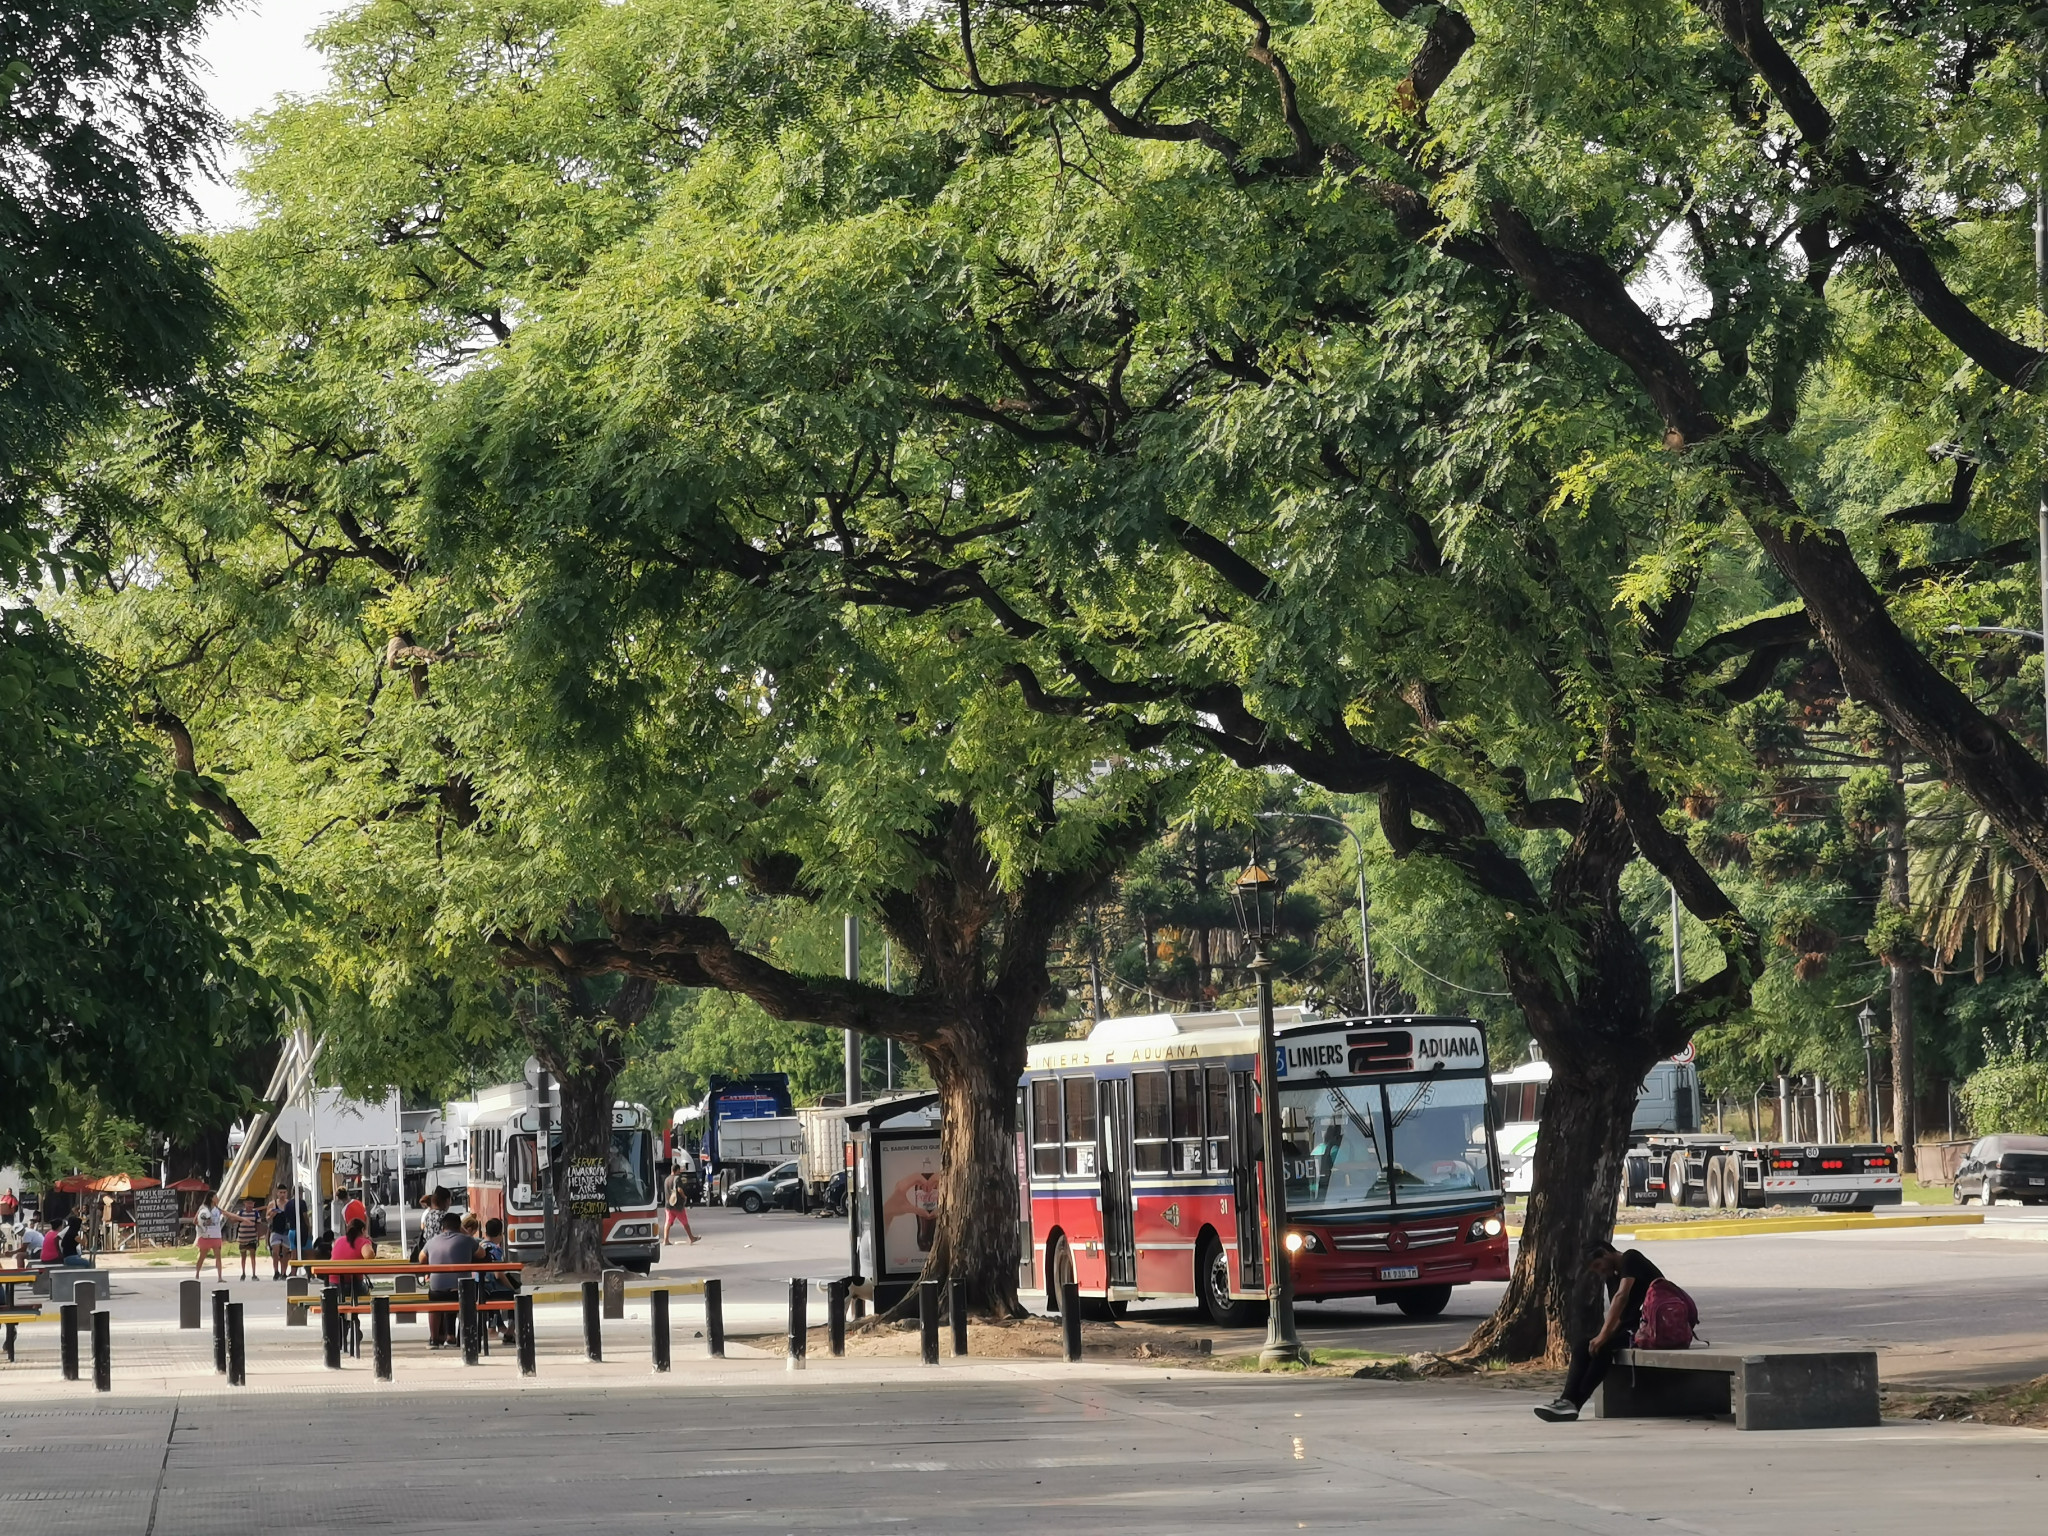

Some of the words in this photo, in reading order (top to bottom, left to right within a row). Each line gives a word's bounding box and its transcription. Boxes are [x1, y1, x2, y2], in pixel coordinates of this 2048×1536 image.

[1106, 1050, 1115, 1063] 2
[1132, 1044, 1199, 1062] ADUANA
[1288, 1044, 1344, 1068] LINIERS
[1346, 1031, 1414, 1074] 2
[1418, 1037, 1480, 1059] ADUANA
[1811, 1192, 1849, 1203] OMBU
[1220, 1199, 1228, 1215] 31
